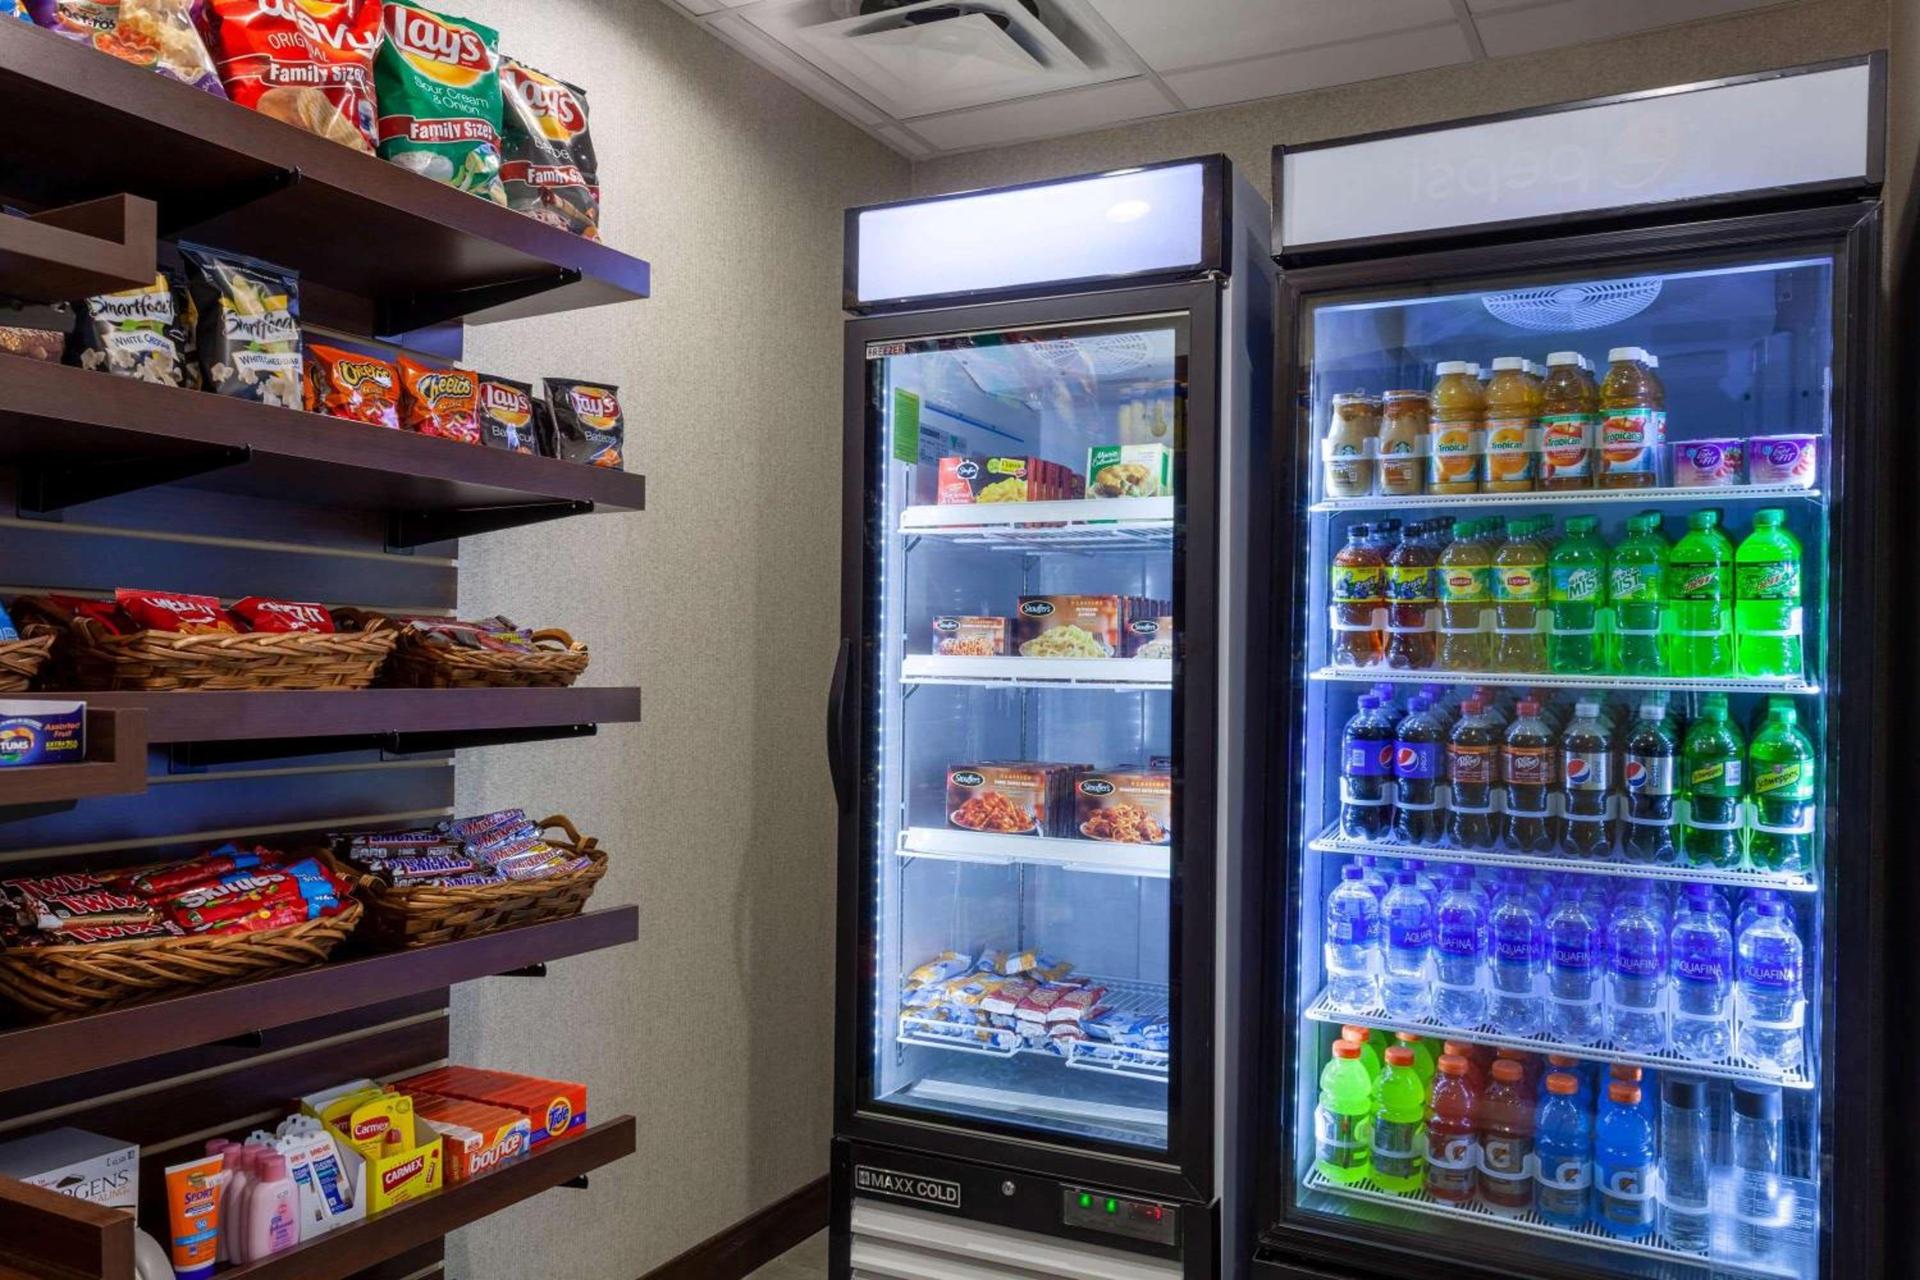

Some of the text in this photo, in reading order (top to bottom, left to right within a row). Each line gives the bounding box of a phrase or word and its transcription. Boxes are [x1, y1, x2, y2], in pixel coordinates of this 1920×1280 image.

[394, 4, 483, 66] Lay's
[269, 63, 327, 82] Family
[414, 75, 490, 109] Sour Cream
[442, 97, 481, 116] Onion
[410, 122, 461, 139] Family
[113, 335, 143, 347] WHITE
[418, 373, 474, 406] Cheetos
[486, 384, 529, 412] Lay's
[573, 393, 616, 417] Lay's
[0, 741, 29, 751] TUMS
[180, 872, 286, 909] Skittles
[355, 1121, 389, 1136] Carmex
[548, 1104, 570, 1132] Tide
[469, 1132, 522, 1174] bounce
[62, 1168, 130, 1200] RGENS
[384, 1157, 424, 1185] CARMEX
[184, 1186, 215, 1205] SPORT
[871, 1173, 957, 1201] MAXX COLD
